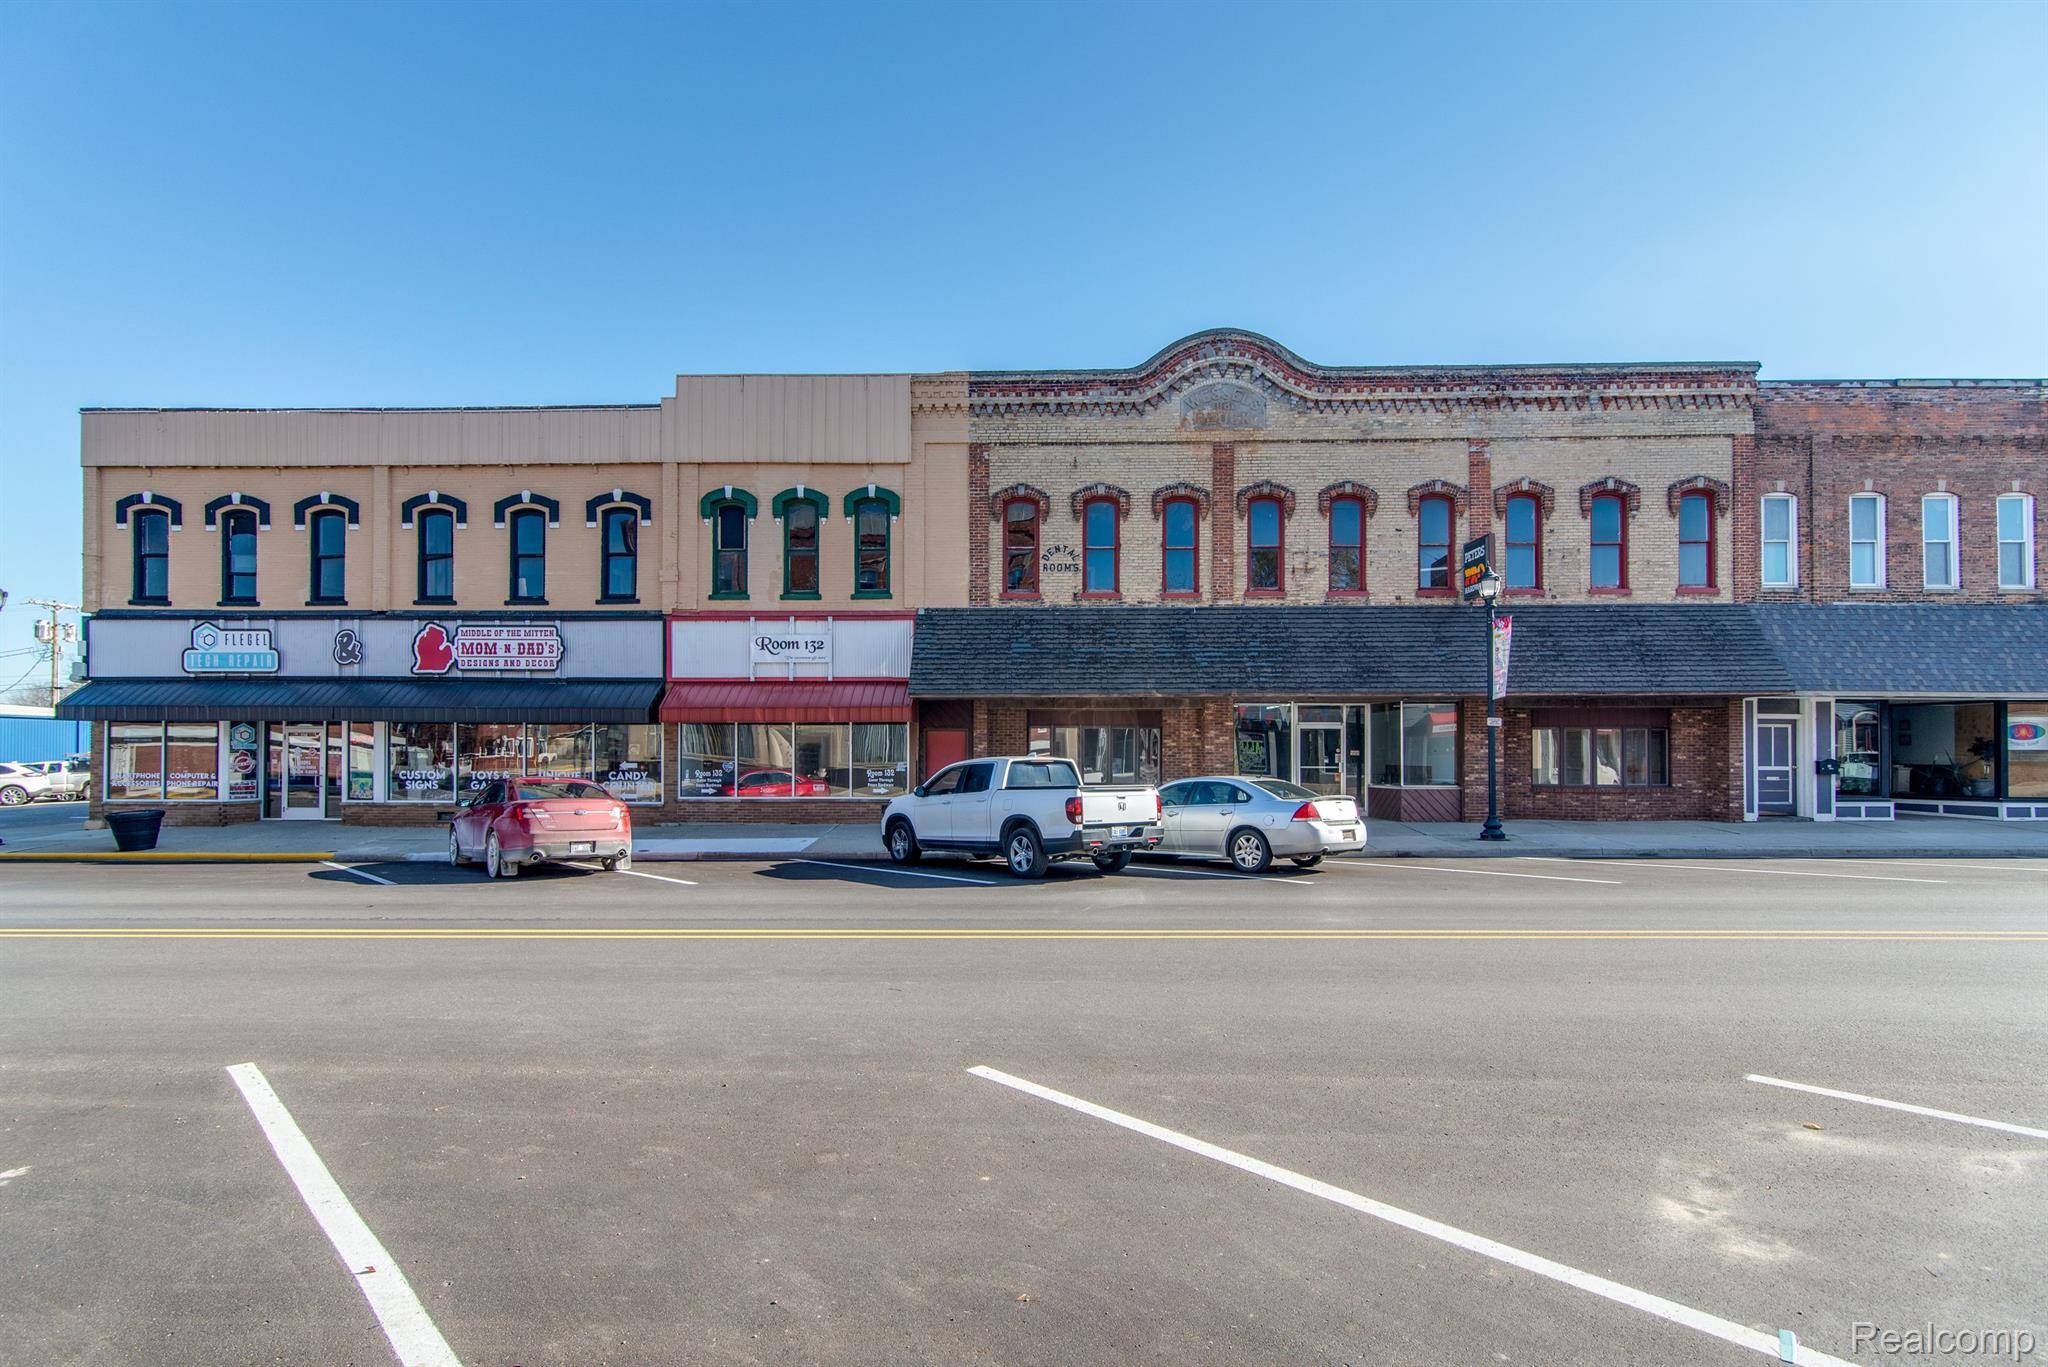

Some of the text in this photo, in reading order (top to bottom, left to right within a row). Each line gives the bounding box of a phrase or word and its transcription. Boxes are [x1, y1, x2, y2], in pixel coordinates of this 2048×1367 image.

[1041, 544, 1080, 561] DENTAL
[1464, 545, 1485, 564] PETERS
[460, 629, 555, 638] MIDDLE OF THE MITTEN
[224, 633, 269, 646] FLEGEL
[460, 642, 498, 655] MOM
[755, 636, 825, 656] Room 132
[190, 654, 273, 668] TECH REPAIR
[460, 659, 555, 668] DESIGNS AND DECOR
[111, 772, 161, 780] SMARTPHONE
[169, 772, 217, 780] COMPUTER &
[399, 770, 446, 780] CUSTOM
[470, 770, 510, 780] TOYS &
[608, 771, 648, 780] CANDY
[866, 769, 895, 779] Room 132
[405, 780, 439, 790] SIGNS
[602, 781, 656, 791] COUNT
